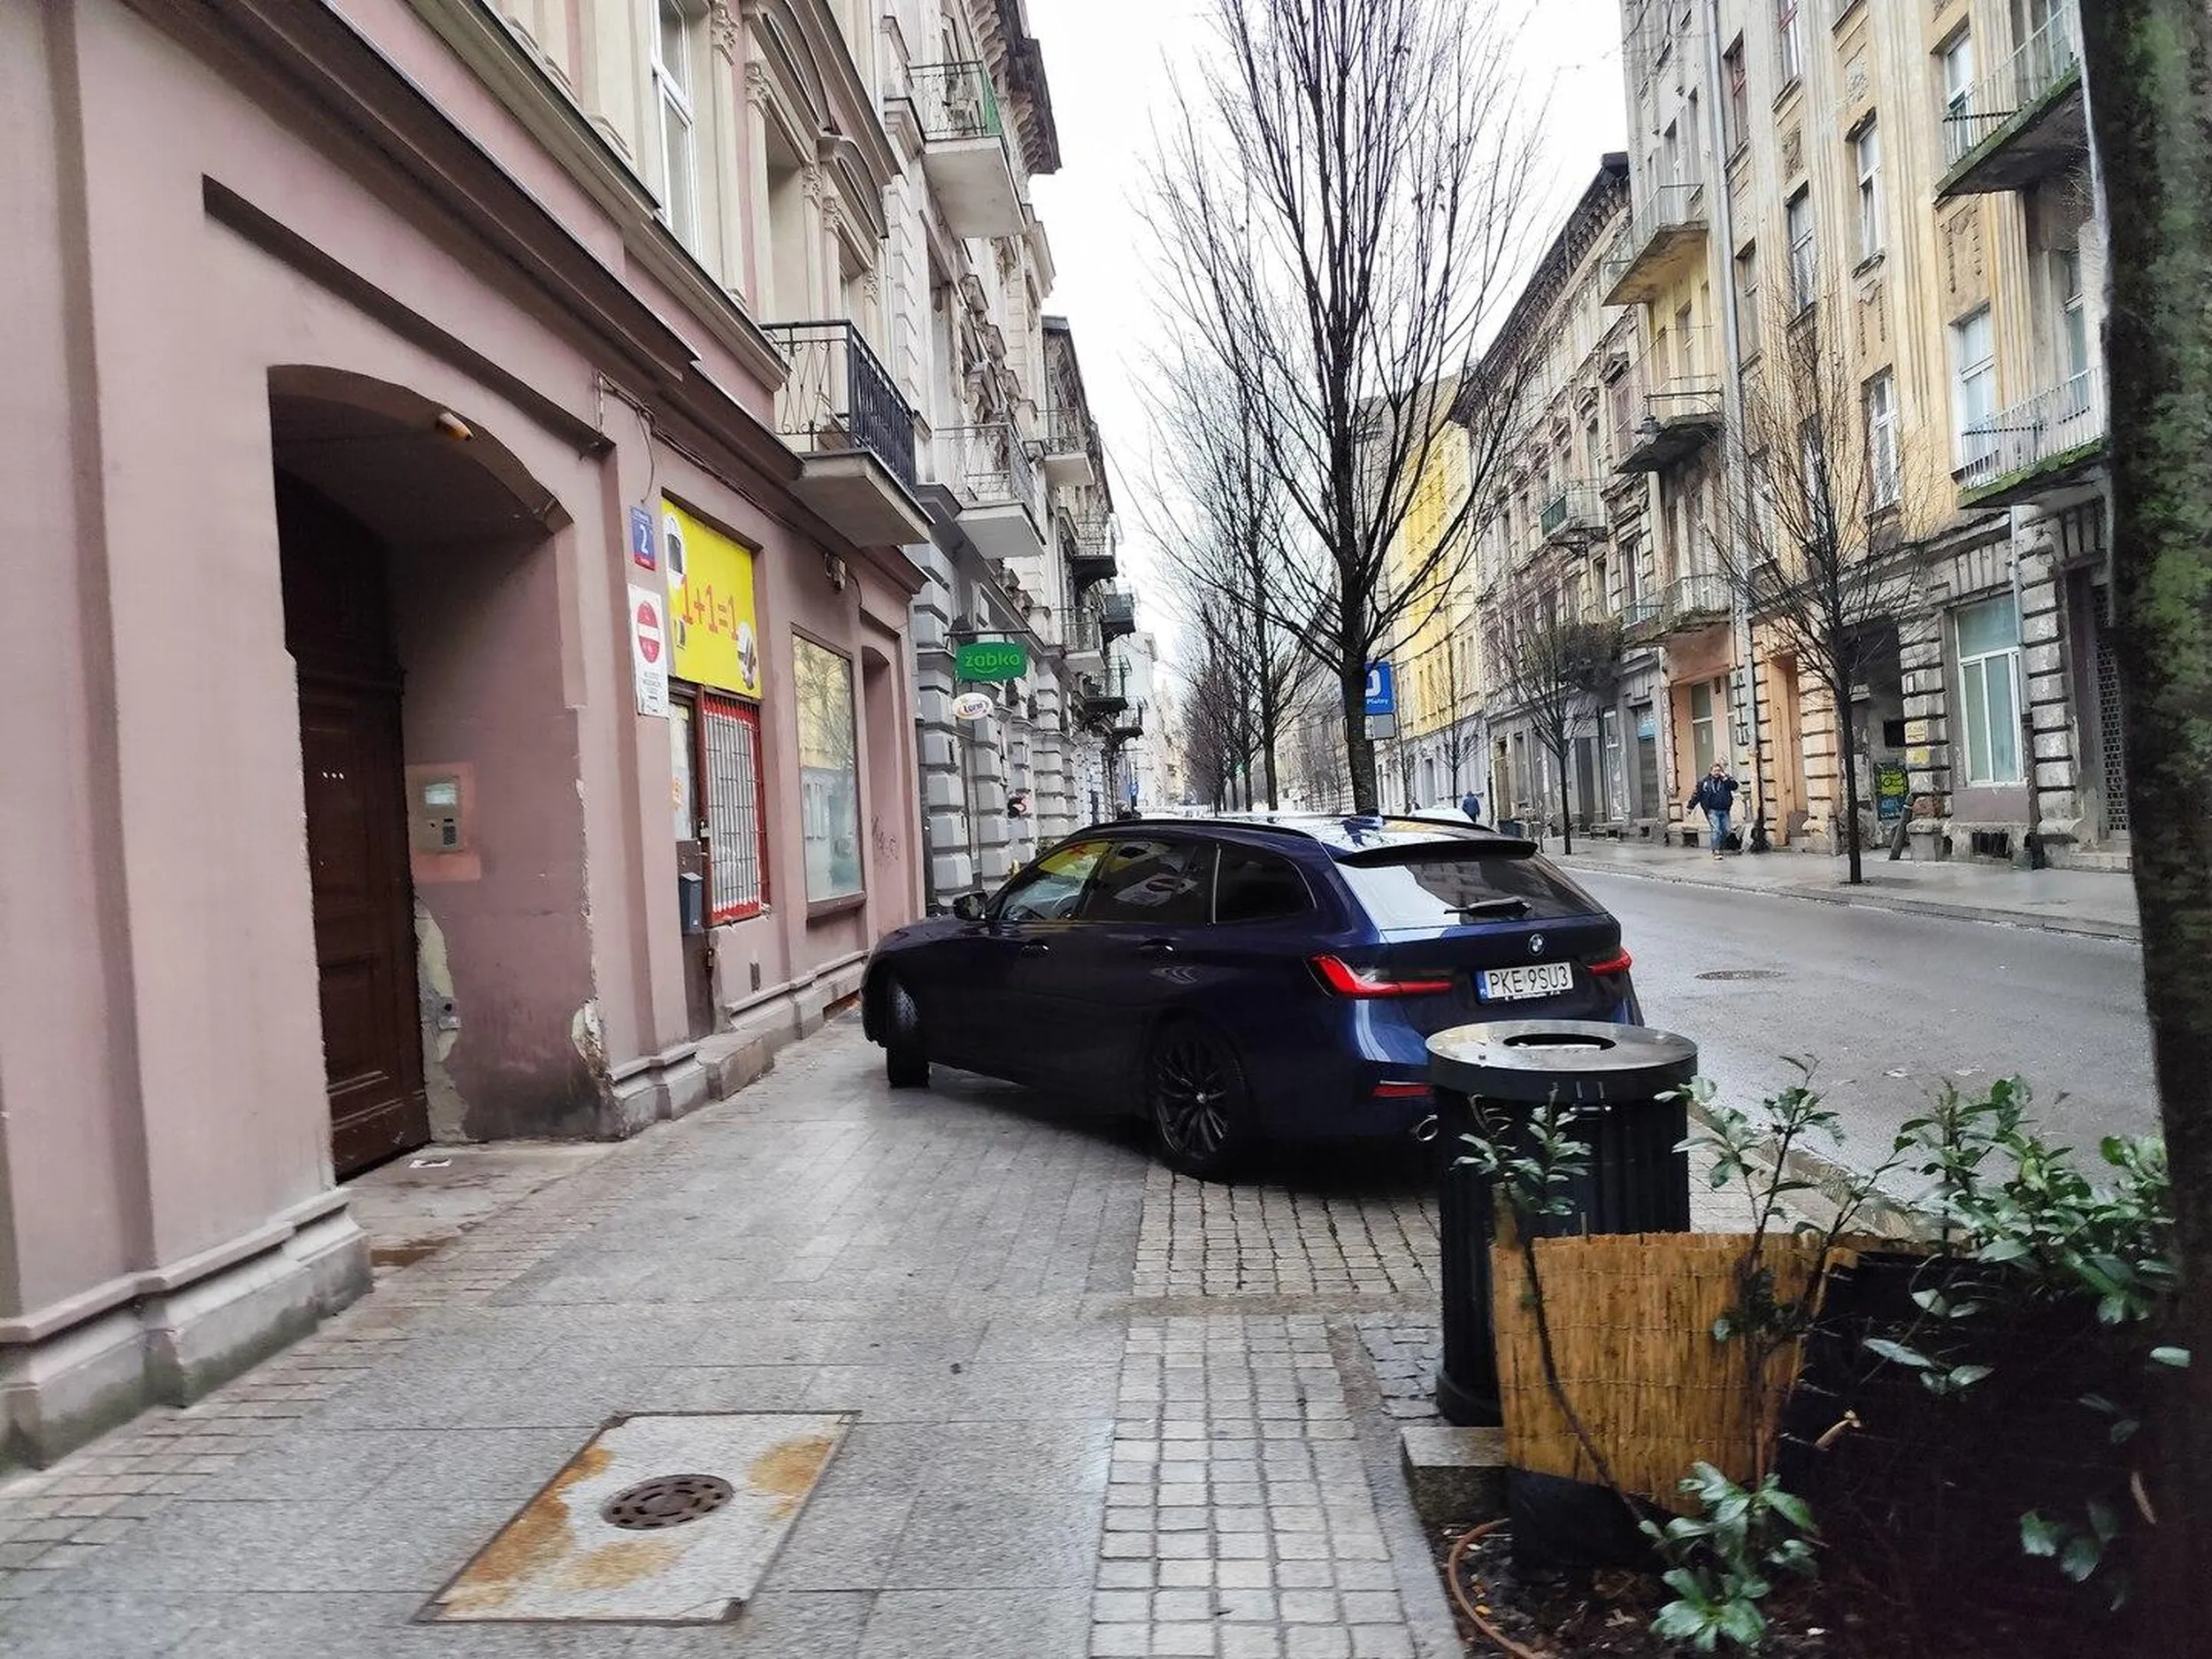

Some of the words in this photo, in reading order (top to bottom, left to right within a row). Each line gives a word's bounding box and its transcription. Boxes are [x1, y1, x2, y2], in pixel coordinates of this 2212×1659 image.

[640, 524, 649, 556] 2
[964, 651, 1020, 669] żabka
[1489, 970, 1524, 995] PKE
[1528, 965, 1568, 992] 9SU3
